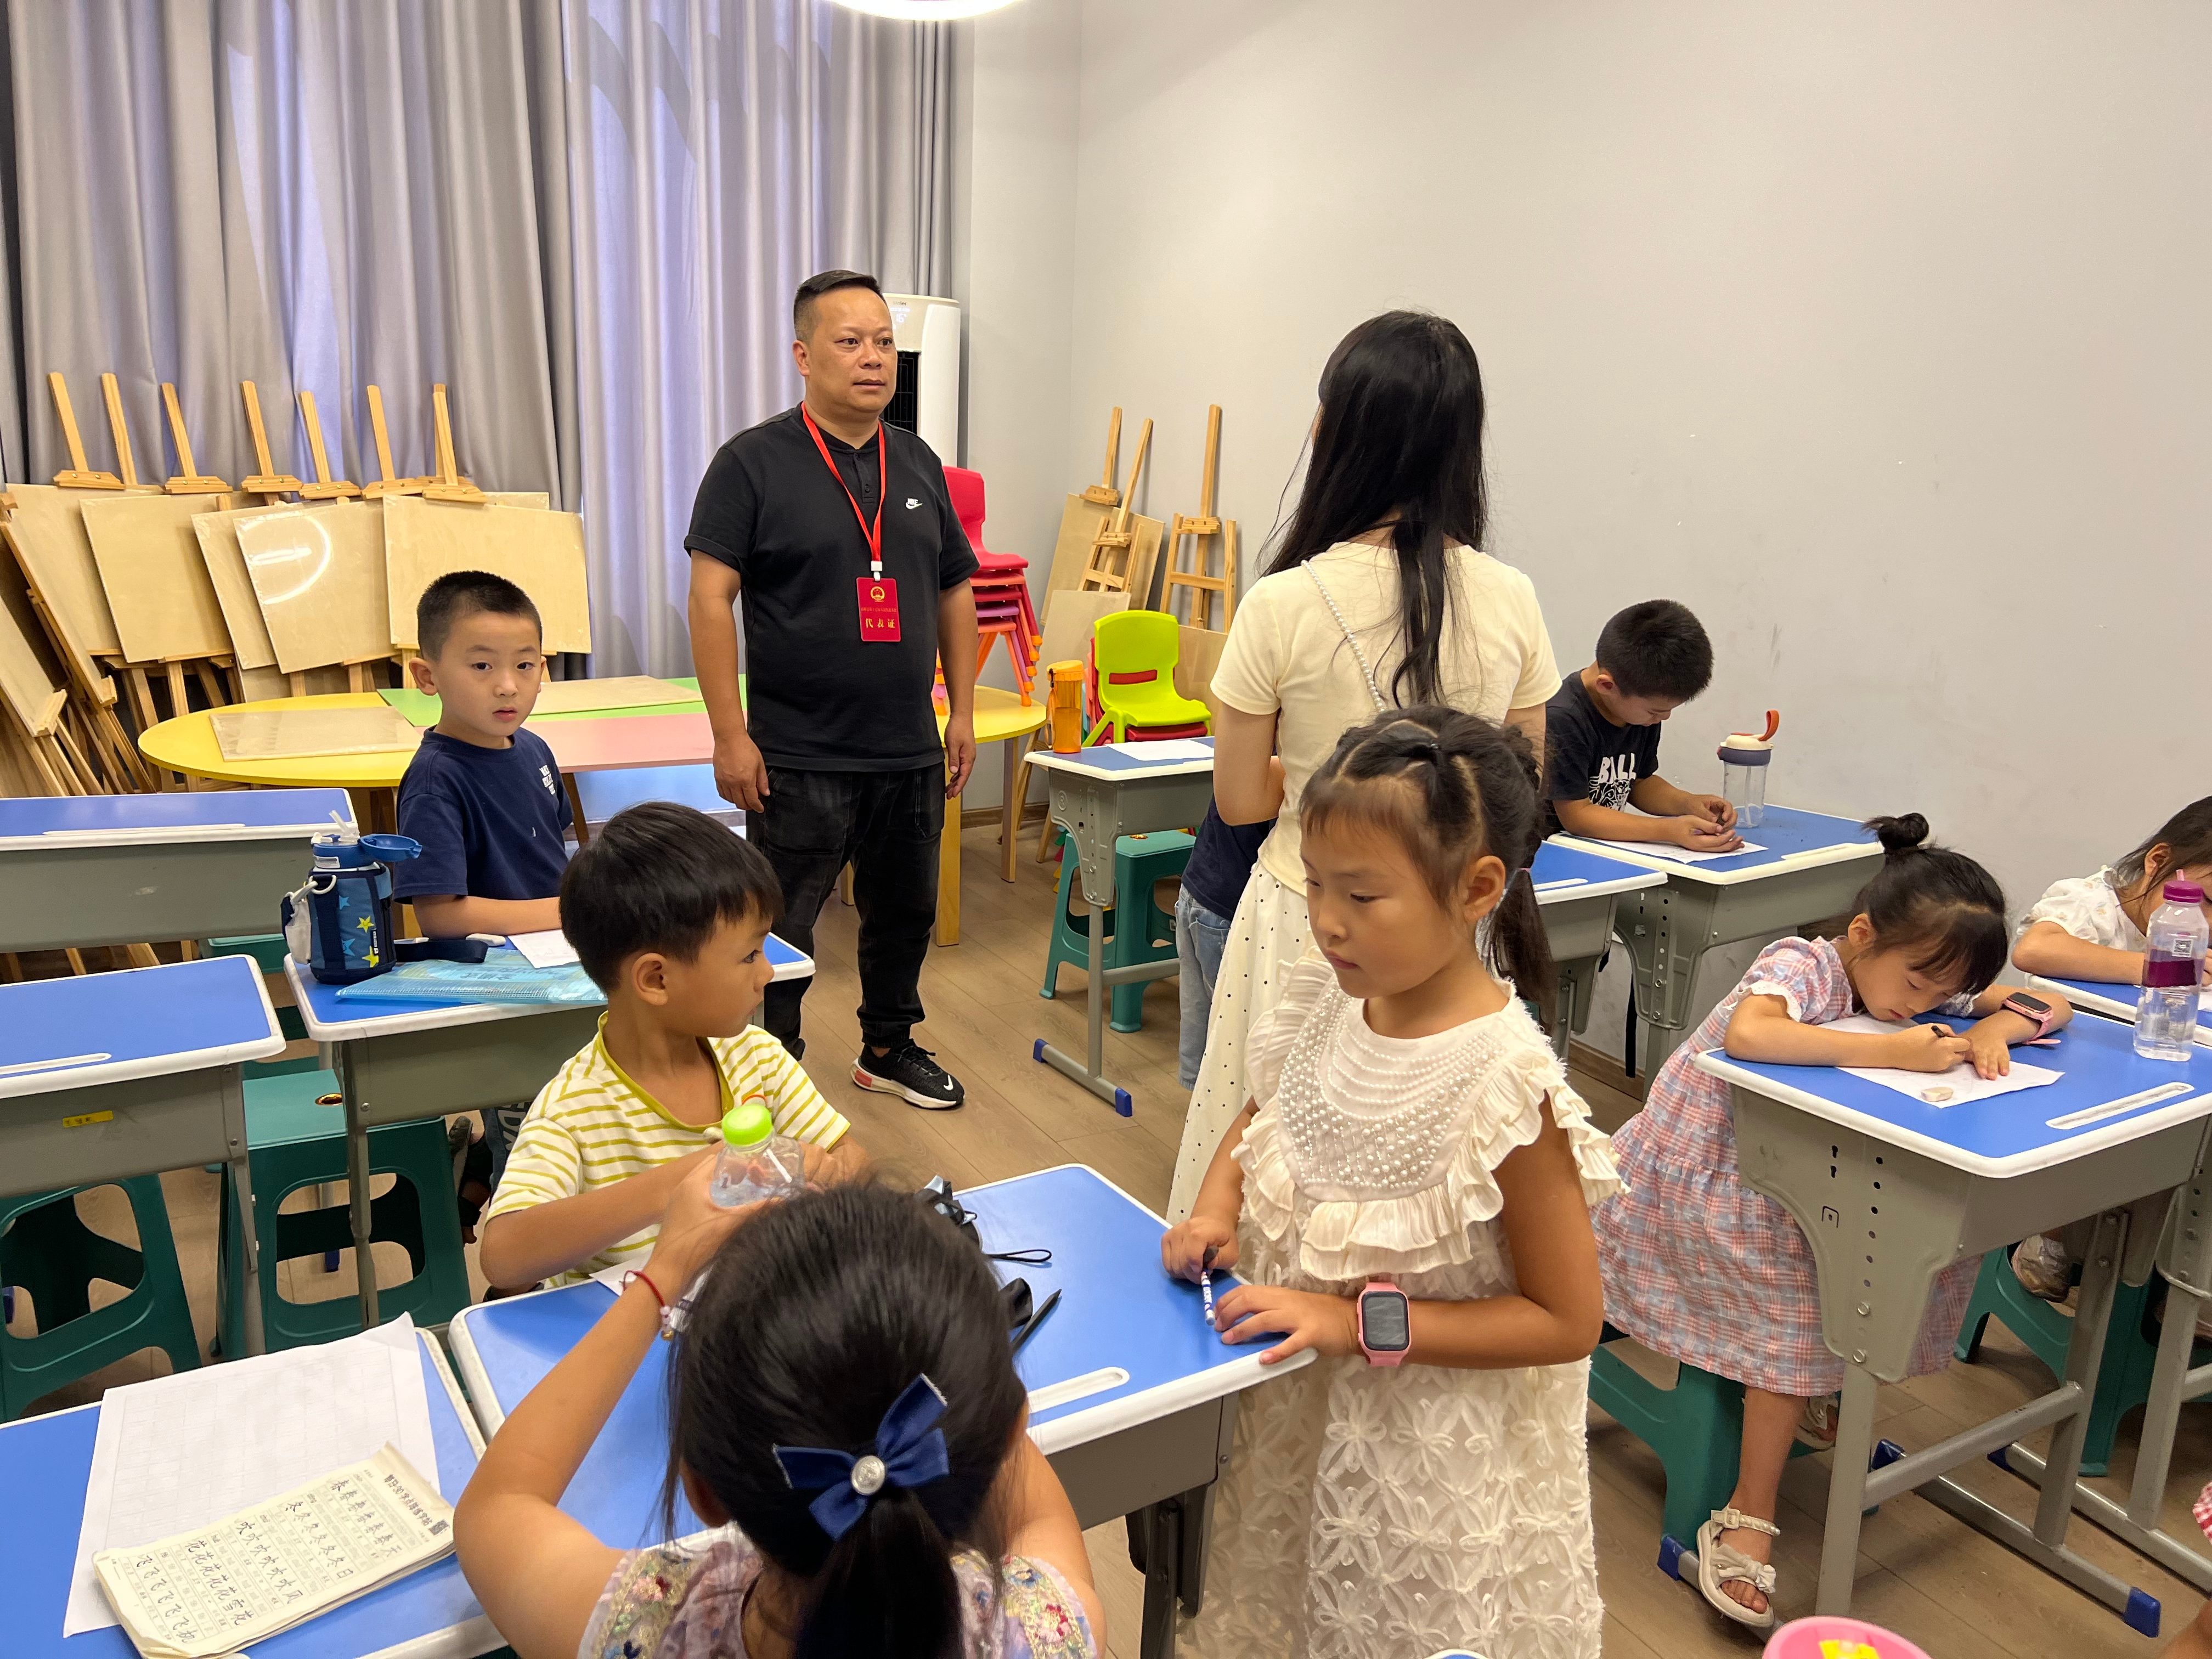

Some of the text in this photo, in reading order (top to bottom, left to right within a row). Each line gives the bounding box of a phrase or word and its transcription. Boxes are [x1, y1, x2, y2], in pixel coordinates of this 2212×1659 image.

[865, 618, 895, 629] 代表证
[1598, 752, 1637, 784] BALL
